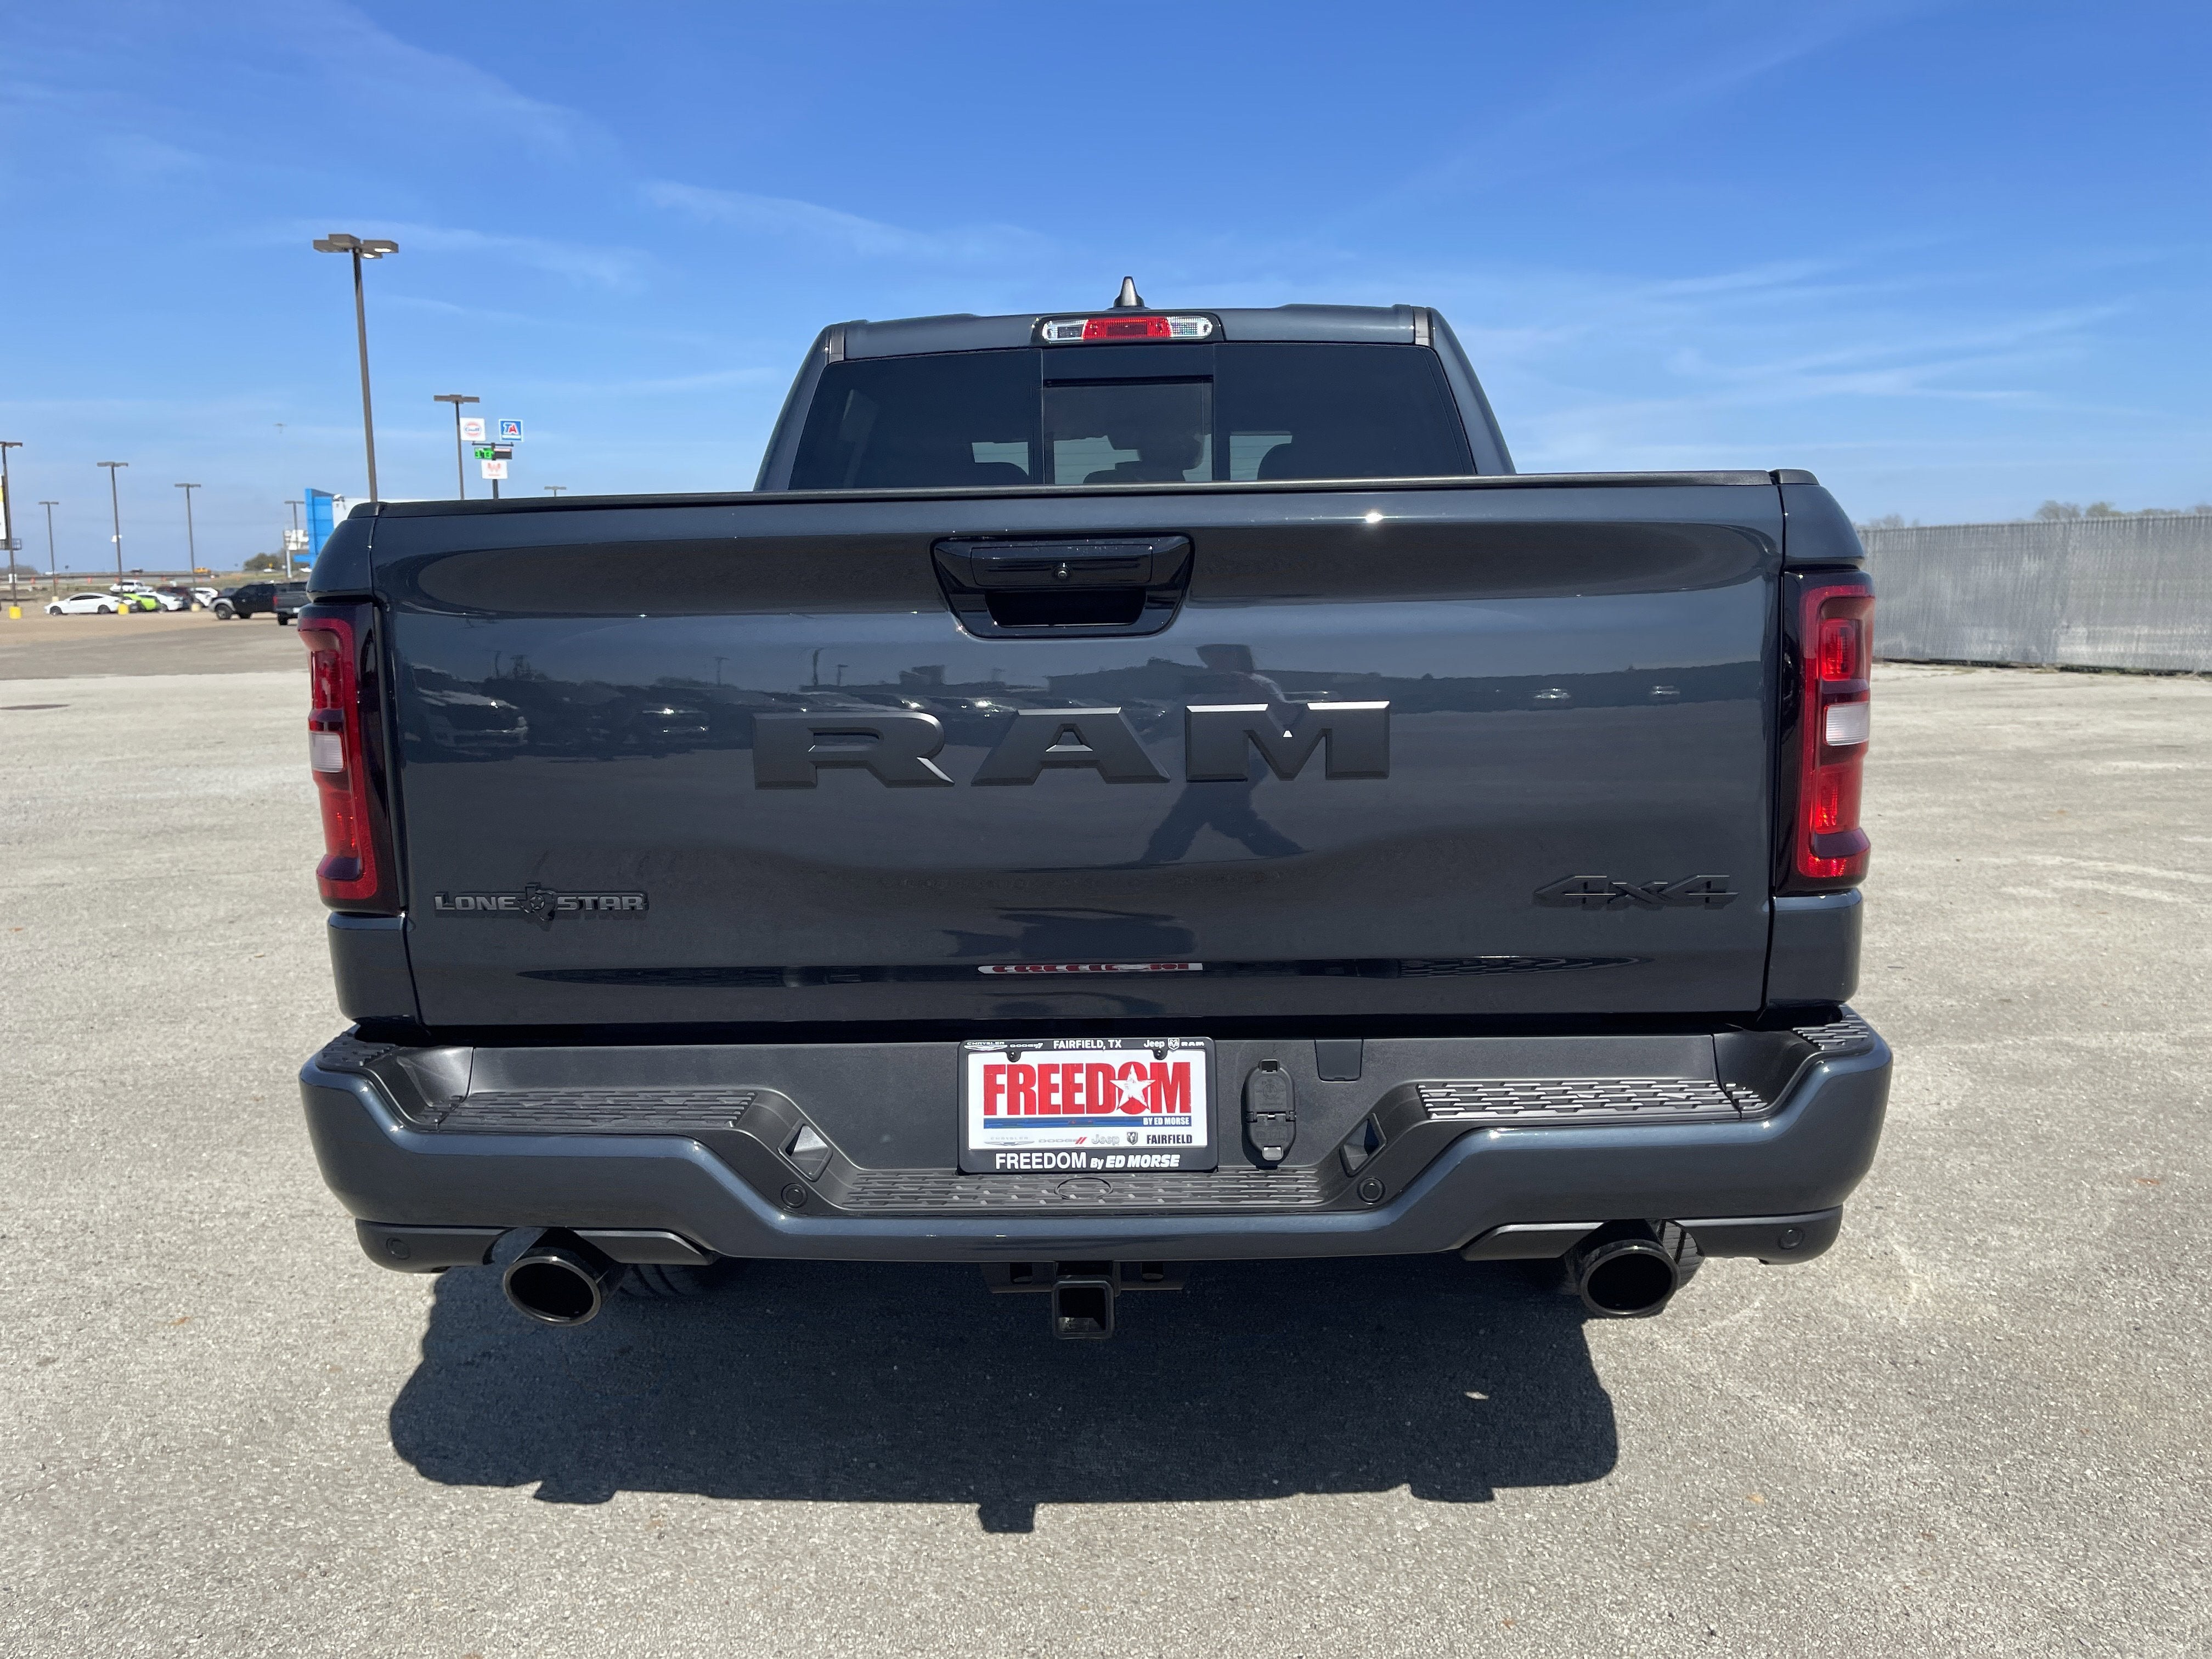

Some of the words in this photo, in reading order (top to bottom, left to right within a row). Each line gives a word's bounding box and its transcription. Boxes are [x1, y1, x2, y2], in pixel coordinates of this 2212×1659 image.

[503, 422, 519, 435] TA
[753, 701, 1390, 789] RAM
[433, 895, 520, 911] LONE
[556, 894, 648, 911] STAR
[1053, 1039, 1106, 1050] FAIRFIELD,
[1108, 1039, 1122, 1048] TX
[1143, 1039, 1165, 1048] Jeep
[983, 1062, 1190, 1115] FREEDOM
[1143, 1117, 1153, 1125] BY
[1154, 1117, 1163, 1125] ED
[1164, 1116, 1189, 1125] MORSE
[1091, 1134, 1120, 1146] Jeep
[1146, 1134, 1193, 1144] FAIRFIELD
[995, 1152, 1087, 1170] FREEDOM
[1090, 1158, 1104, 1170] By
[1105, 1155, 1126, 1168] ED
[1127, 1154, 1181, 1168] MORSE
